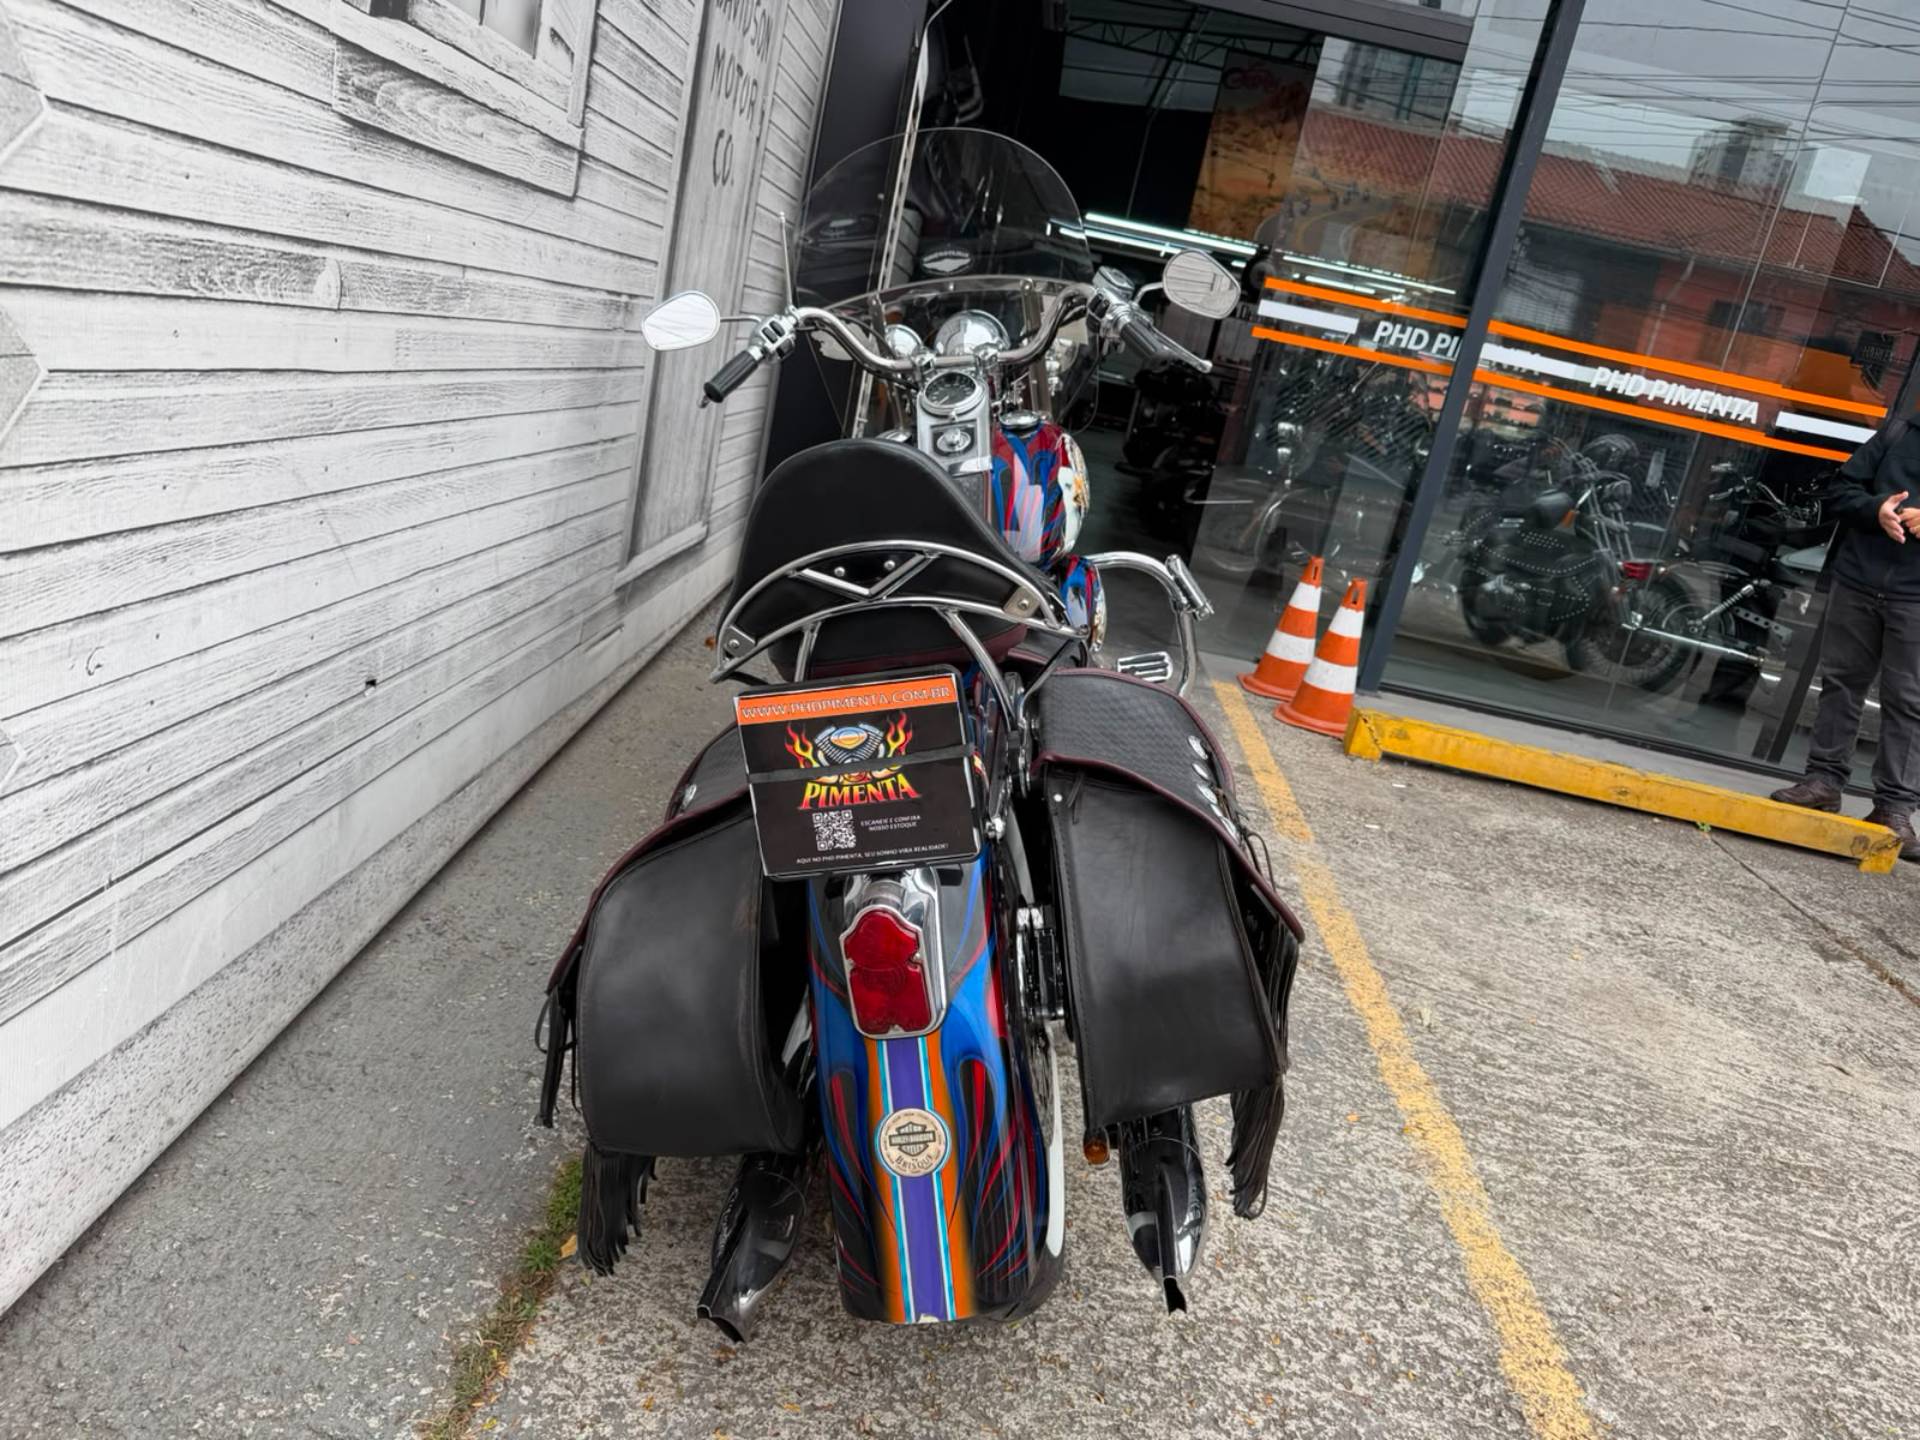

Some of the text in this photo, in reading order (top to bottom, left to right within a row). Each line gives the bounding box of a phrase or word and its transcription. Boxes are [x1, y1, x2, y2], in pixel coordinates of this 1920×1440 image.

[711, 42, 757, 130] MOTOR
[1373, 320, 1430, 351] PHD
[1590, 366, 1759, 425] PHD PIMENTA
[799, 772, 921, 810] PIMENTA
